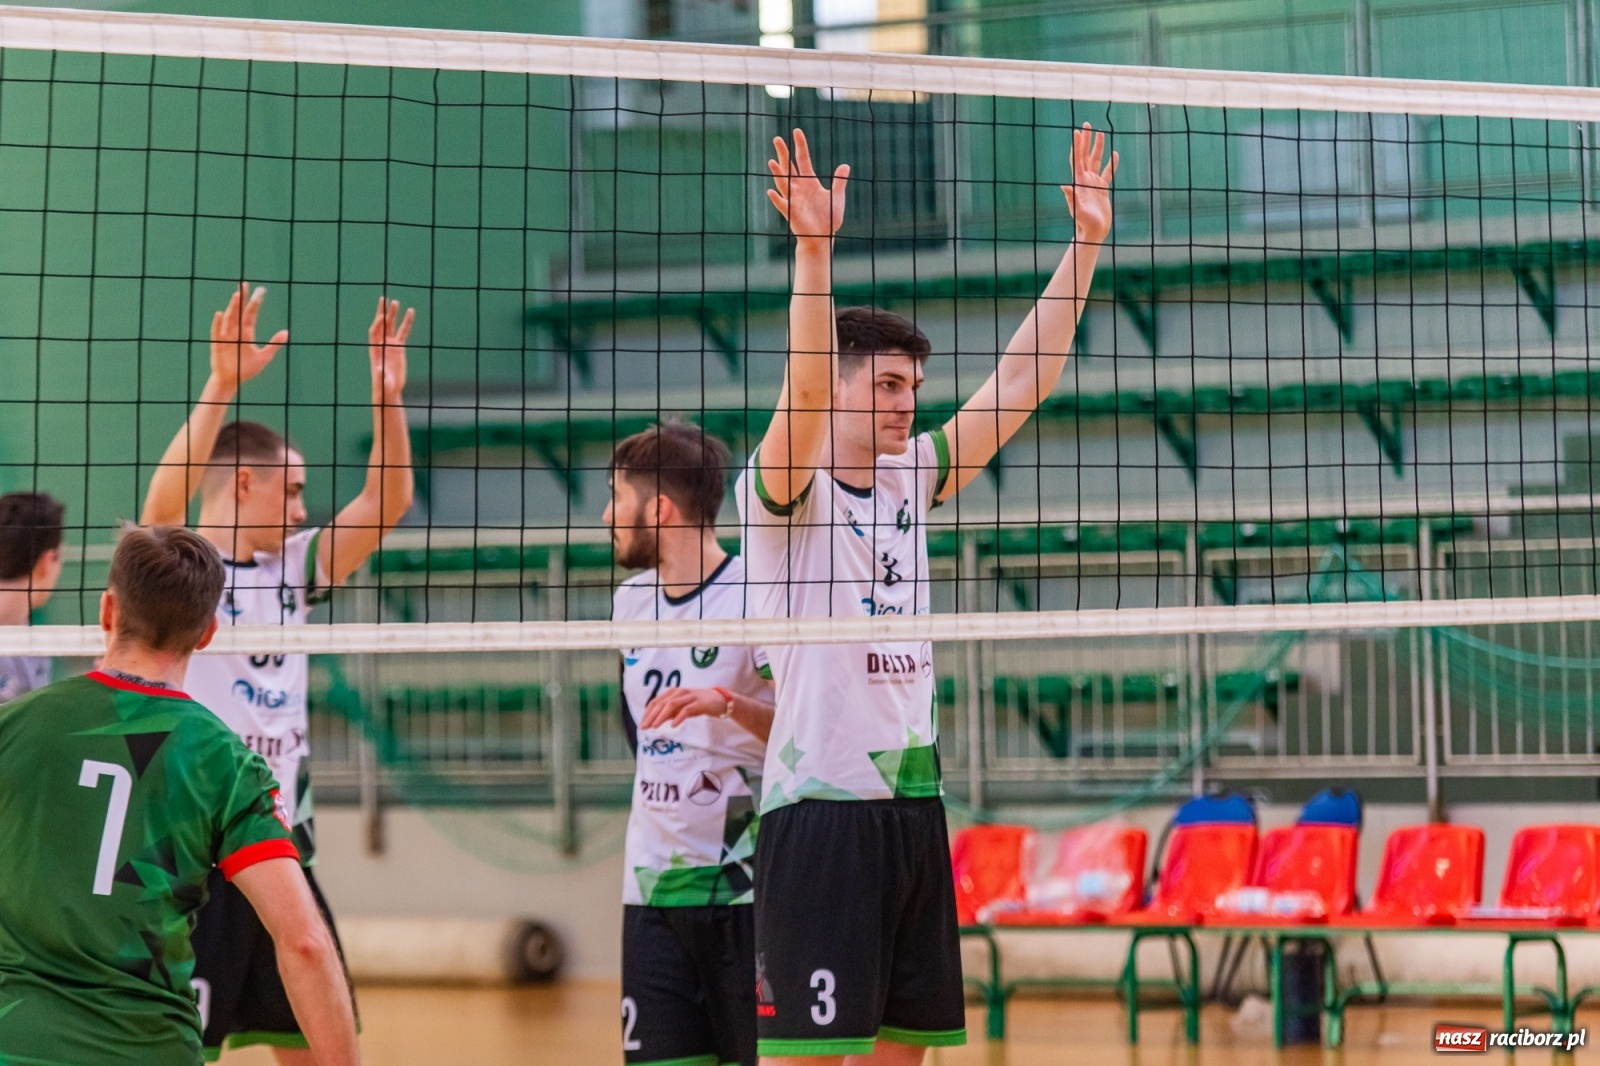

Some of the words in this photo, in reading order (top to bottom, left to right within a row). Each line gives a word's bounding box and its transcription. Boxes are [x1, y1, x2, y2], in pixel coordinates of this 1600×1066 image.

[866, 653, 917, 674] DELTA
[78, 759, 133, 896] 7
[621, 996, 642, 1051] 2
[809, 968, 837, 1026] 3
